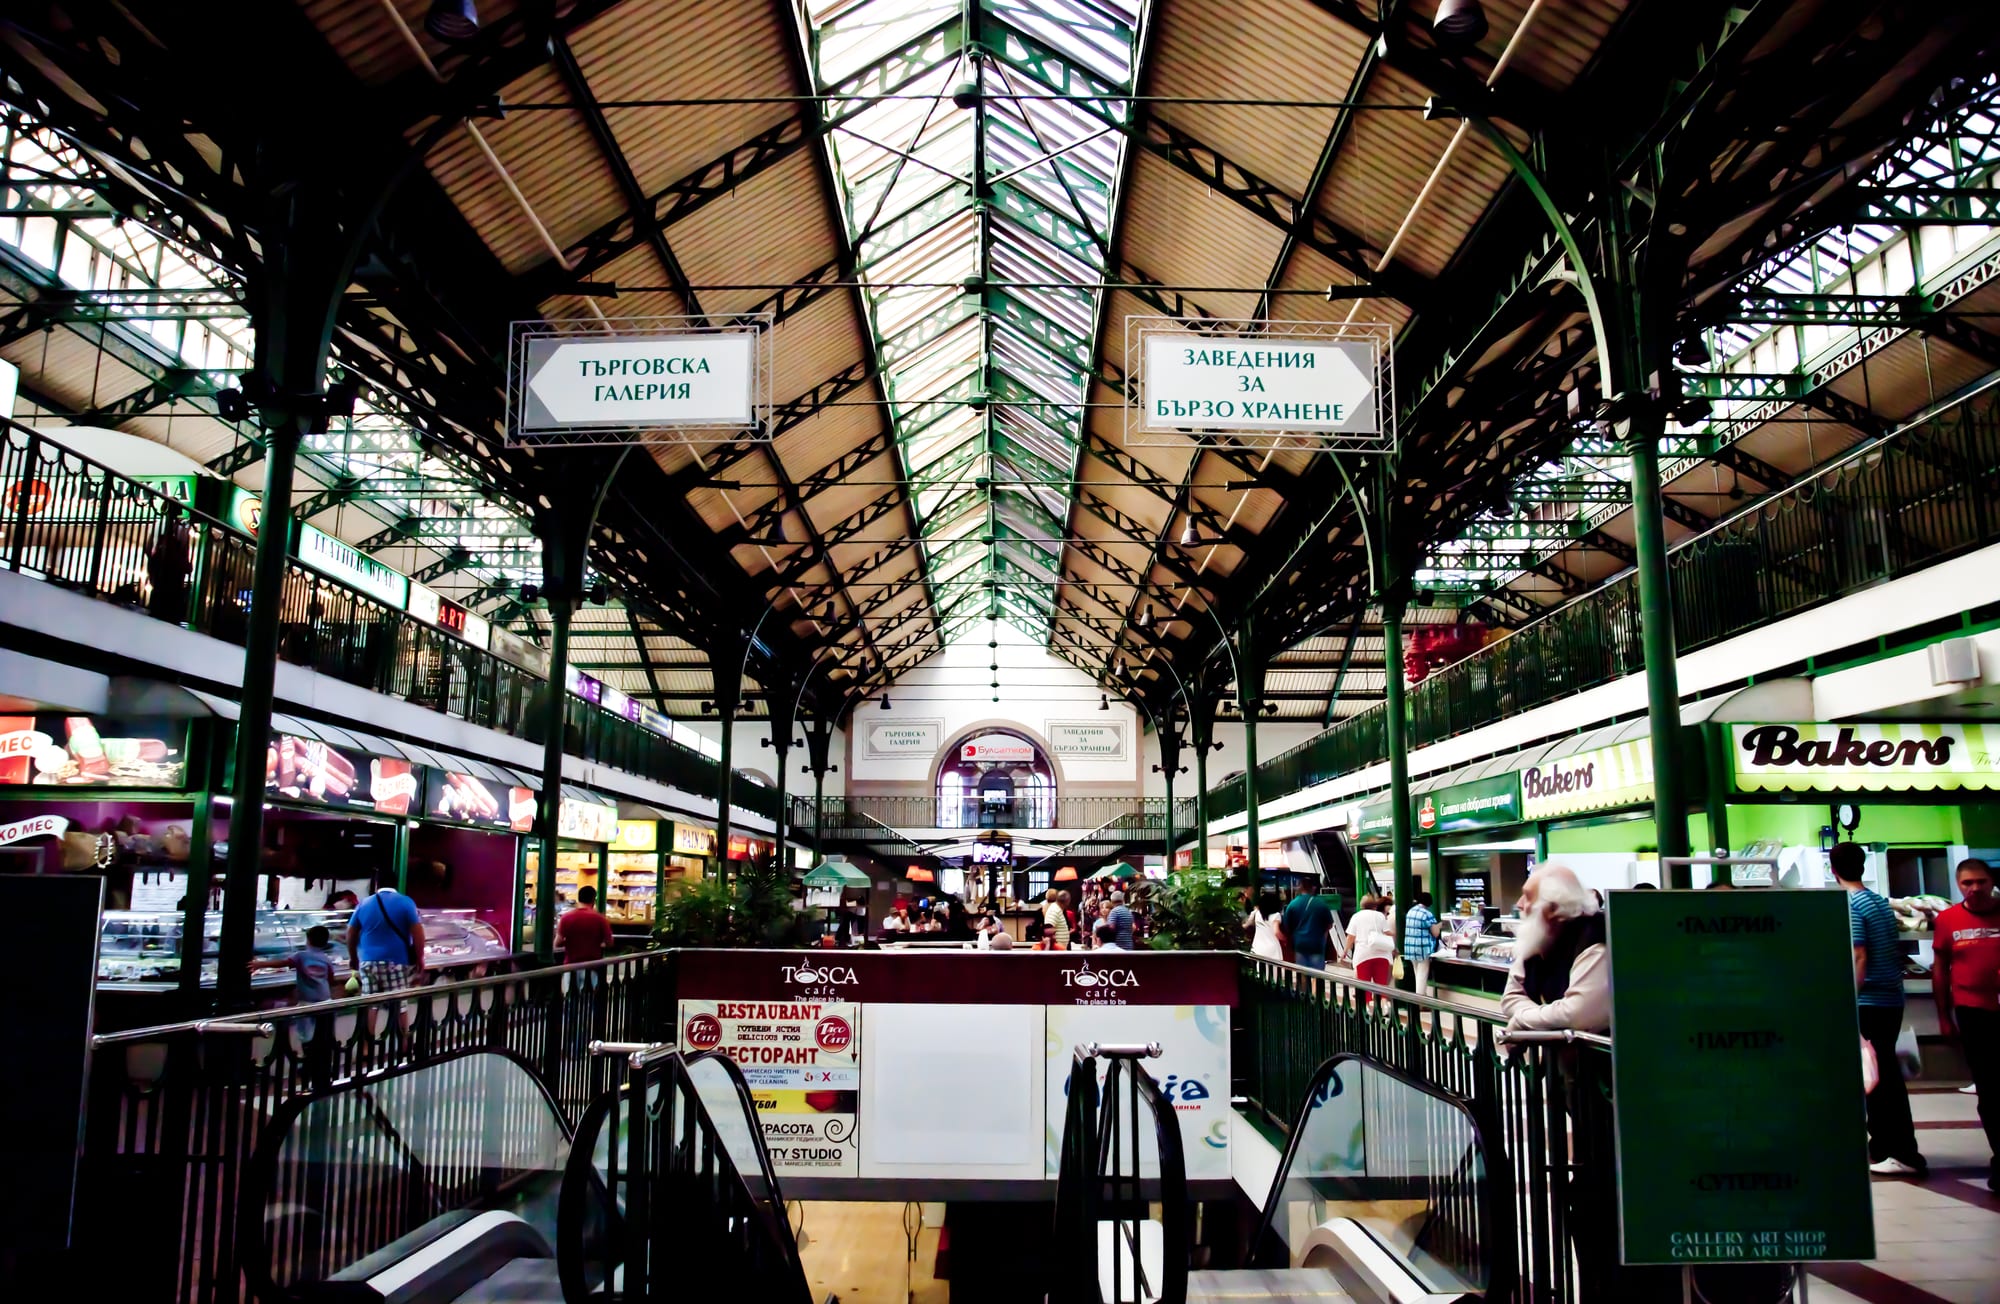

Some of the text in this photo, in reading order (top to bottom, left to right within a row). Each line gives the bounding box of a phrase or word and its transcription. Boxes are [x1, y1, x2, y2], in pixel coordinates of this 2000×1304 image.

[578, 356, 711, 377] ТЪРГОВСКА
[1183, 348, 1315, 370] ЗАВЕДЕНИЯ
[594, 383, 691, 402] ГАЛЕРИЯ
[1237, 375, 1266, 393] ЗА
[1157, 399, 1344, 421] БЪРЗО ХРАНЕНЕ
[437, 605, 466, 631] ART
[883, 730, 926, 739] ТЪРГОВСКА
[1062, 728, 1105, 737] ЗАВЕДЕНИЯ
[1079, 736, 1088, 744] ЗА
[888, 738, 921, 747] ГАЛЕРИЯ
[1741, 724, 1956, 767] Bakers
[1523, 762, 1595, 799] Bakers
[781, 966, 860, 985] TOSCA
[1061, 969, 1140, 987] TOSCA
[804, 985, 836, 995] cafe
[1085, 988, 1117, 998] cafe
[717, 1003, 822, 1020] RESTAURANT
[775, 1025, 801, 1033] ЯСТИЯ
[791, 1148, 843, 1160] STUDIO
[1670, 1231, 1827, 1244] GALLERY ART SHOP
[1671, 1245, 1828, 1258] GALLERY ART SHOP
